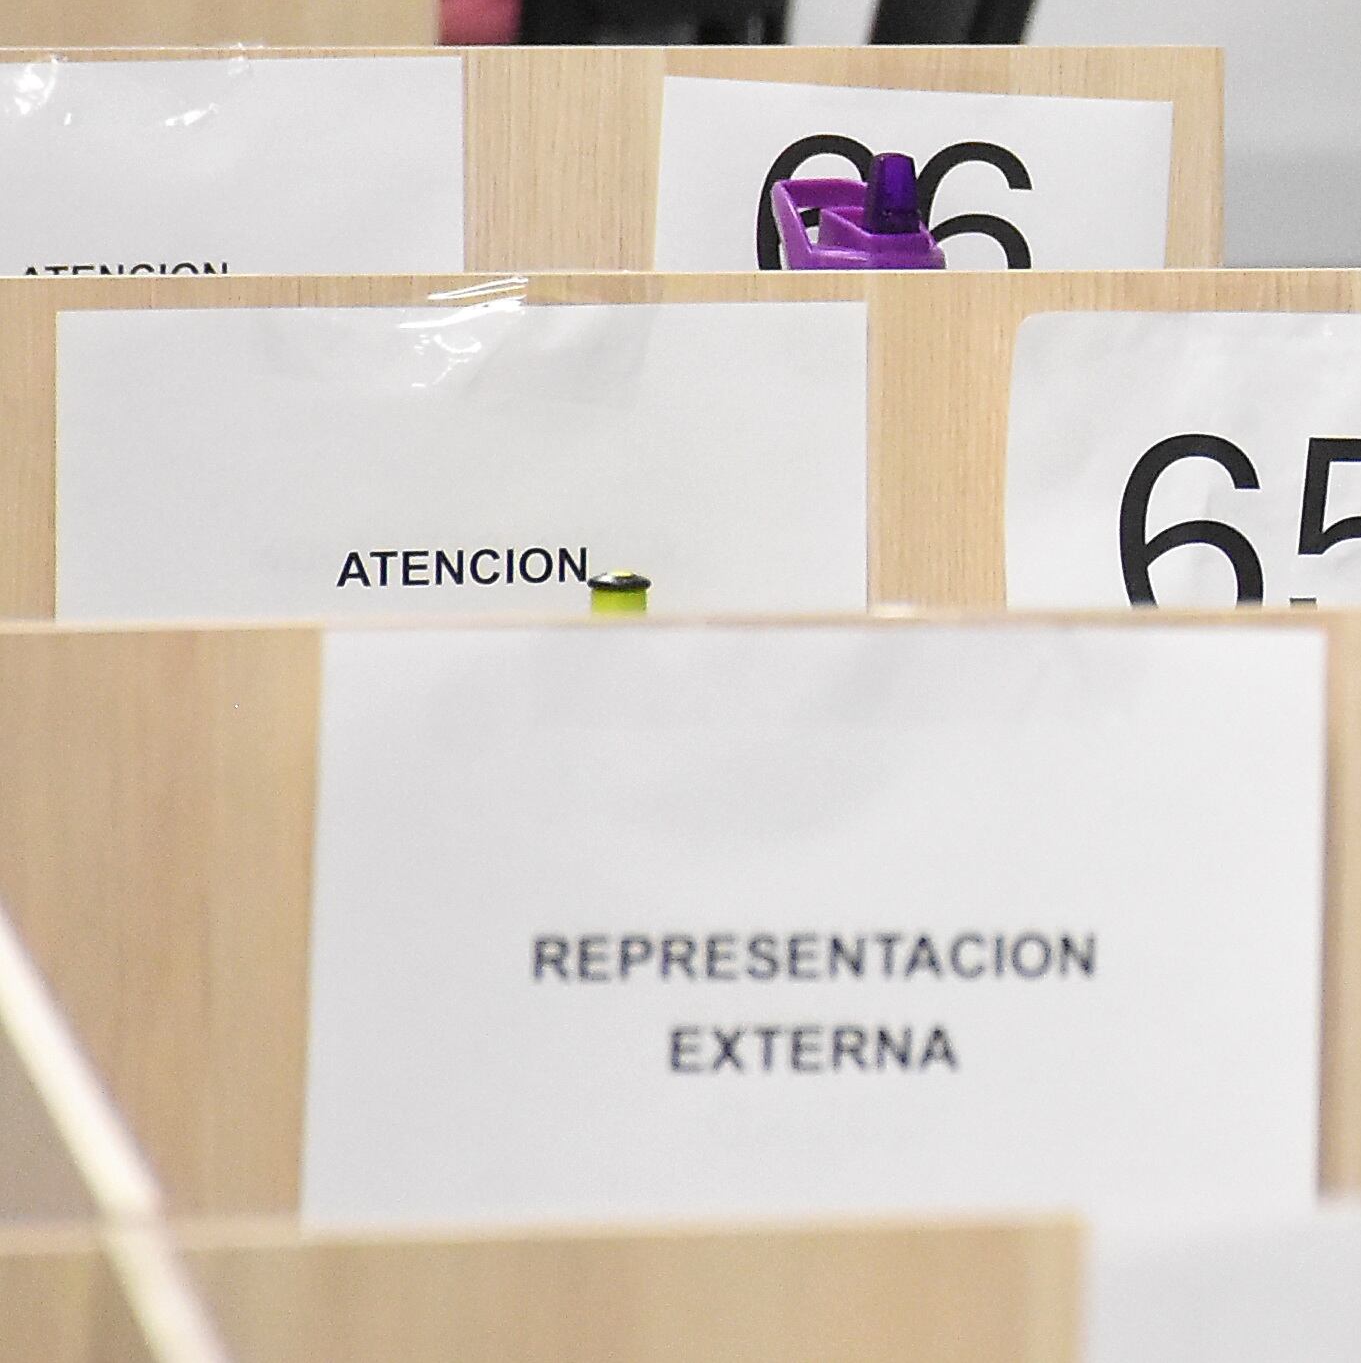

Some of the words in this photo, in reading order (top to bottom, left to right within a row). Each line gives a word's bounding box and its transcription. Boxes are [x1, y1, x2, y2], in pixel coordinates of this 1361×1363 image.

[336, 546, 588, 588] ATENCION
[532, 932, 1097, 982] REPRESENTACION
[669, 1025, 958, 1073] EXTERNA
